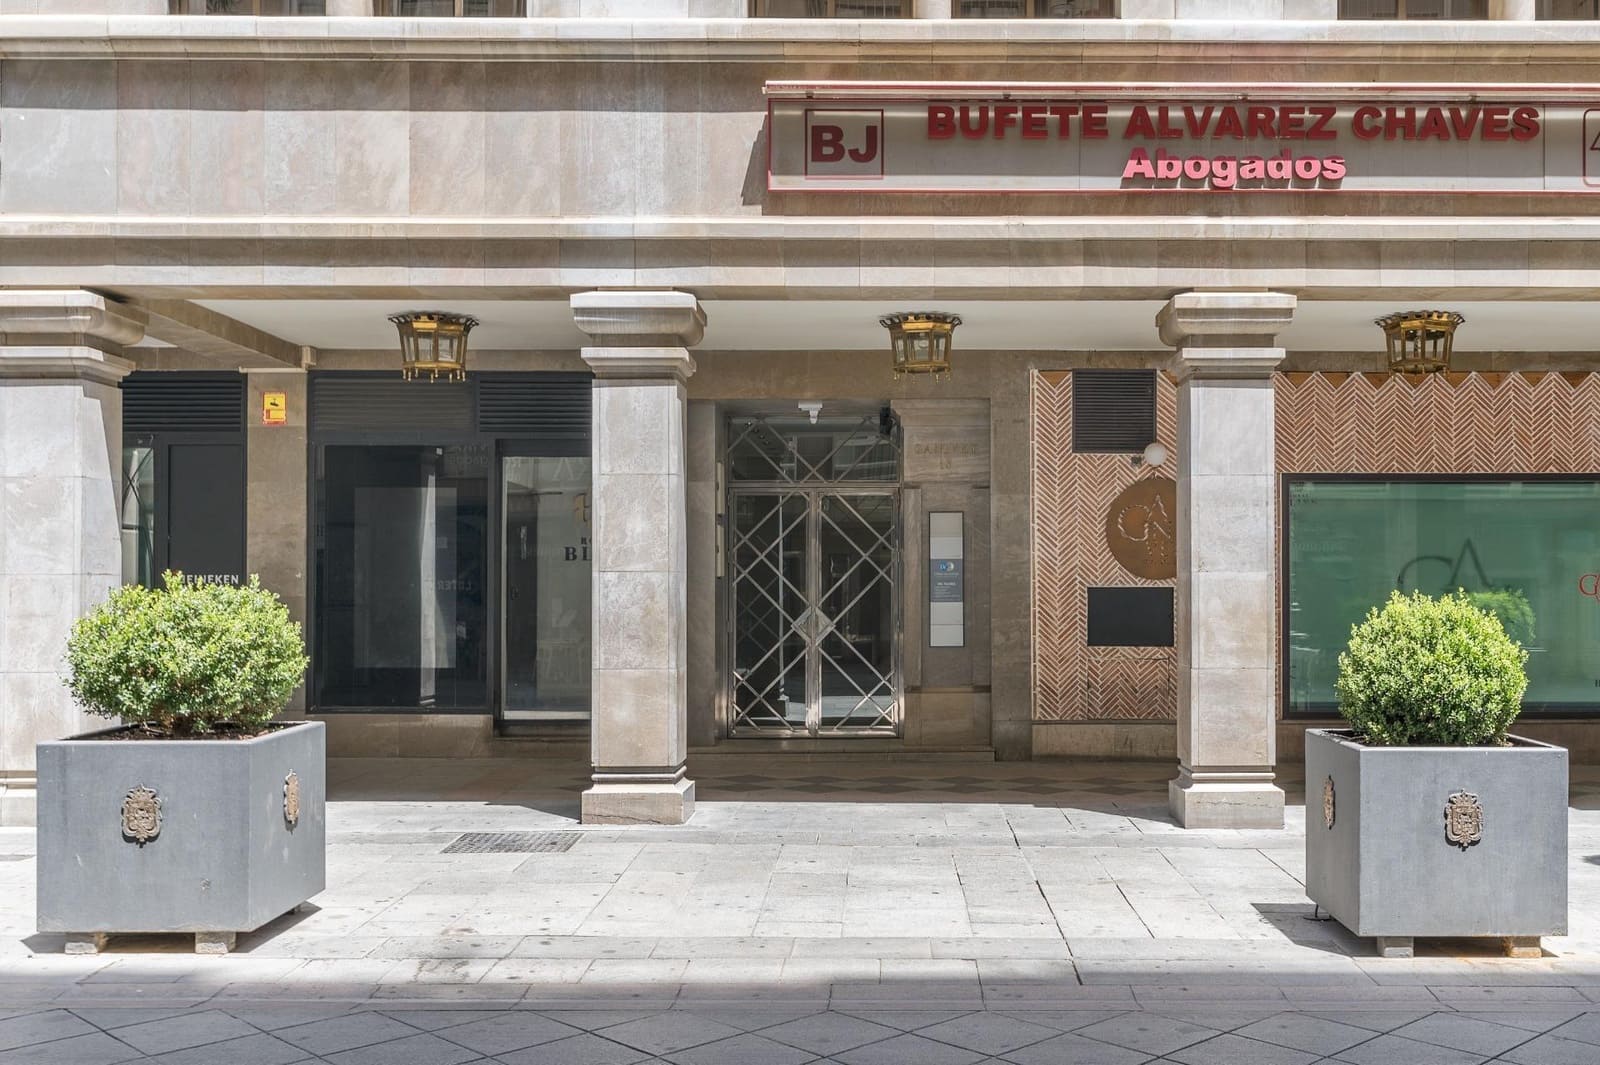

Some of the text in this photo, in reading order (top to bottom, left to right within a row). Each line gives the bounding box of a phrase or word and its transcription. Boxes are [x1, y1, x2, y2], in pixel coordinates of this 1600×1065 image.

[927, 105, 1540, 141] BUFETE ALVAREZ CHAVES
[810, 124, 879, 164] BJ
[1122, 147, 1346, 189] Abogados
